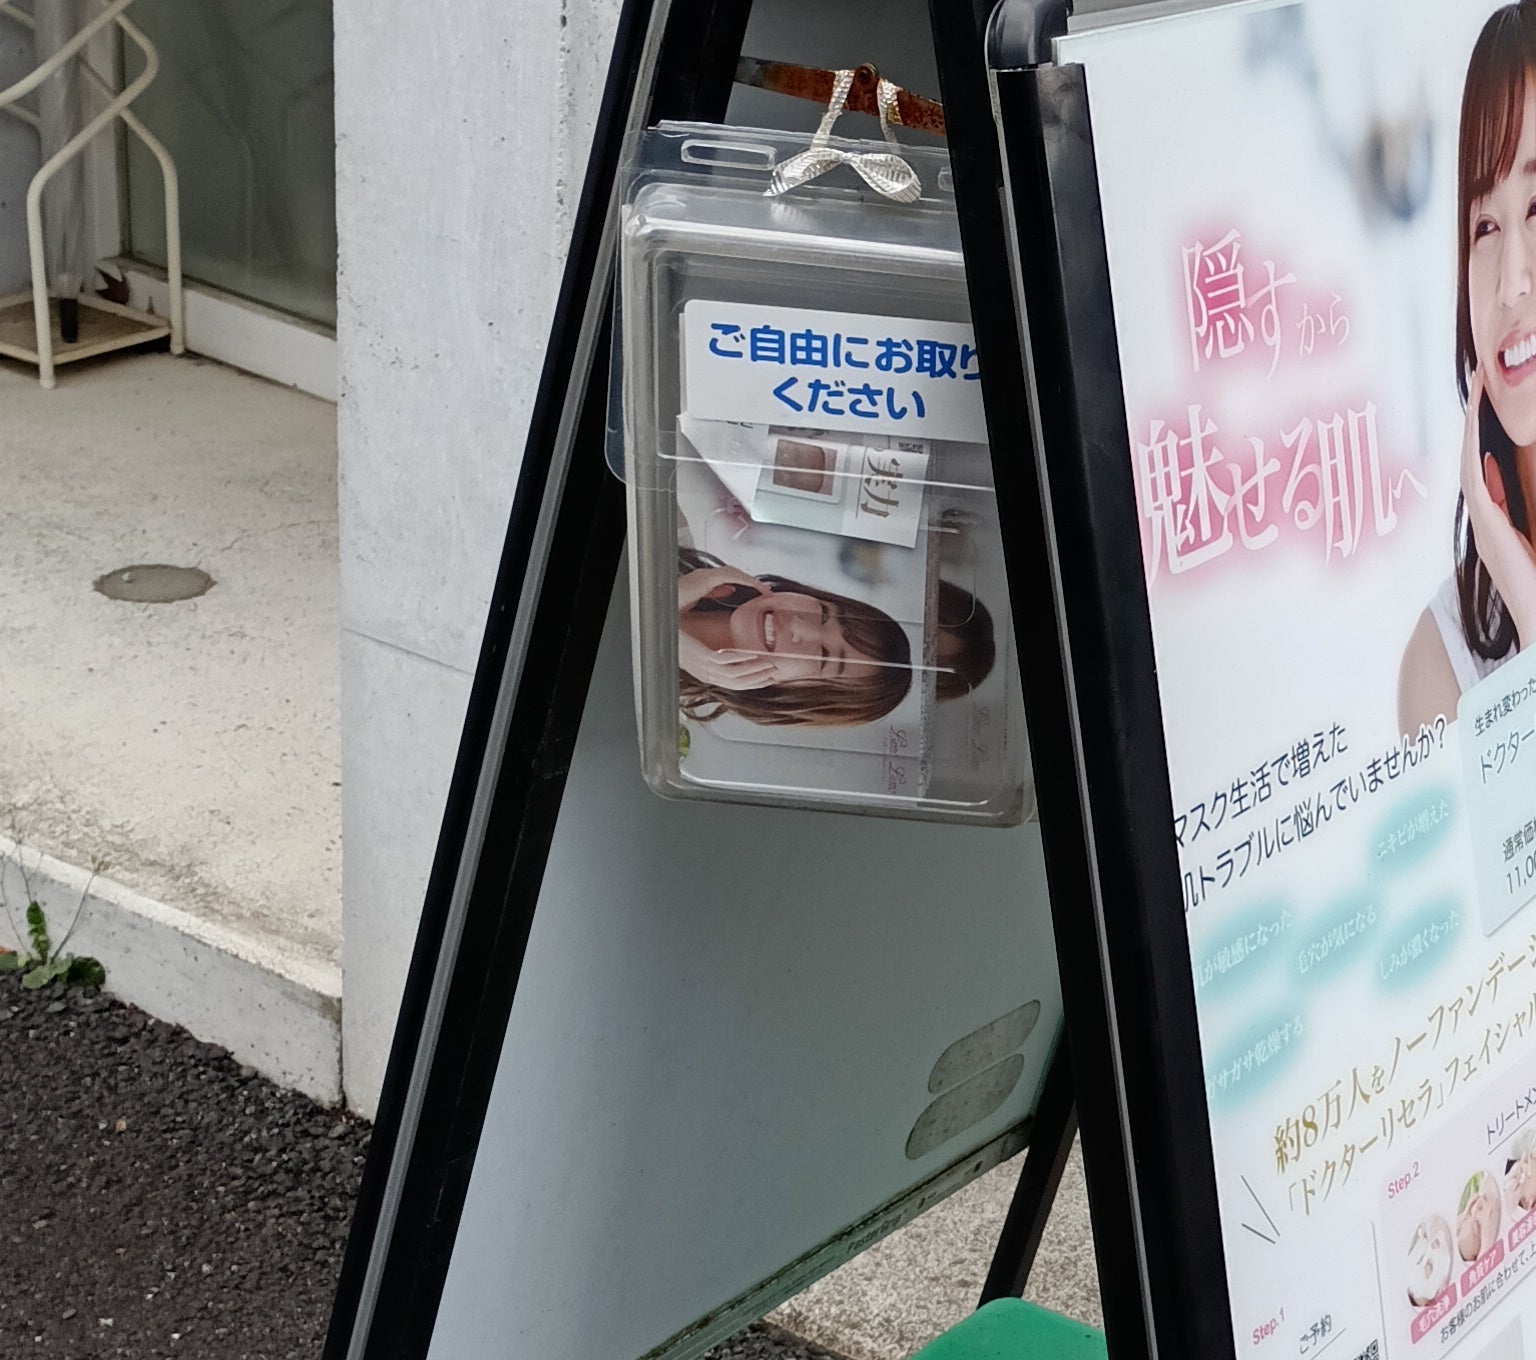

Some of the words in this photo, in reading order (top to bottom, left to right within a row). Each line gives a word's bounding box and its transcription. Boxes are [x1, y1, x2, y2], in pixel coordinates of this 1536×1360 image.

[1181, 228, 1352, 380] 隠すから
[773, 377, 926, 420] ください
[859, 446, 903, 518] 実力
[1137, 400, 1428, 576] 魅せる肌へ
[1174, 720, 1349, 848] マスク生活で増えた
[1387, 1162, 1420, 1199] Step.2
[1252, 1308, 1286, 1346] Step.1
[1298, 1313, 1332, 1355] ご予約
